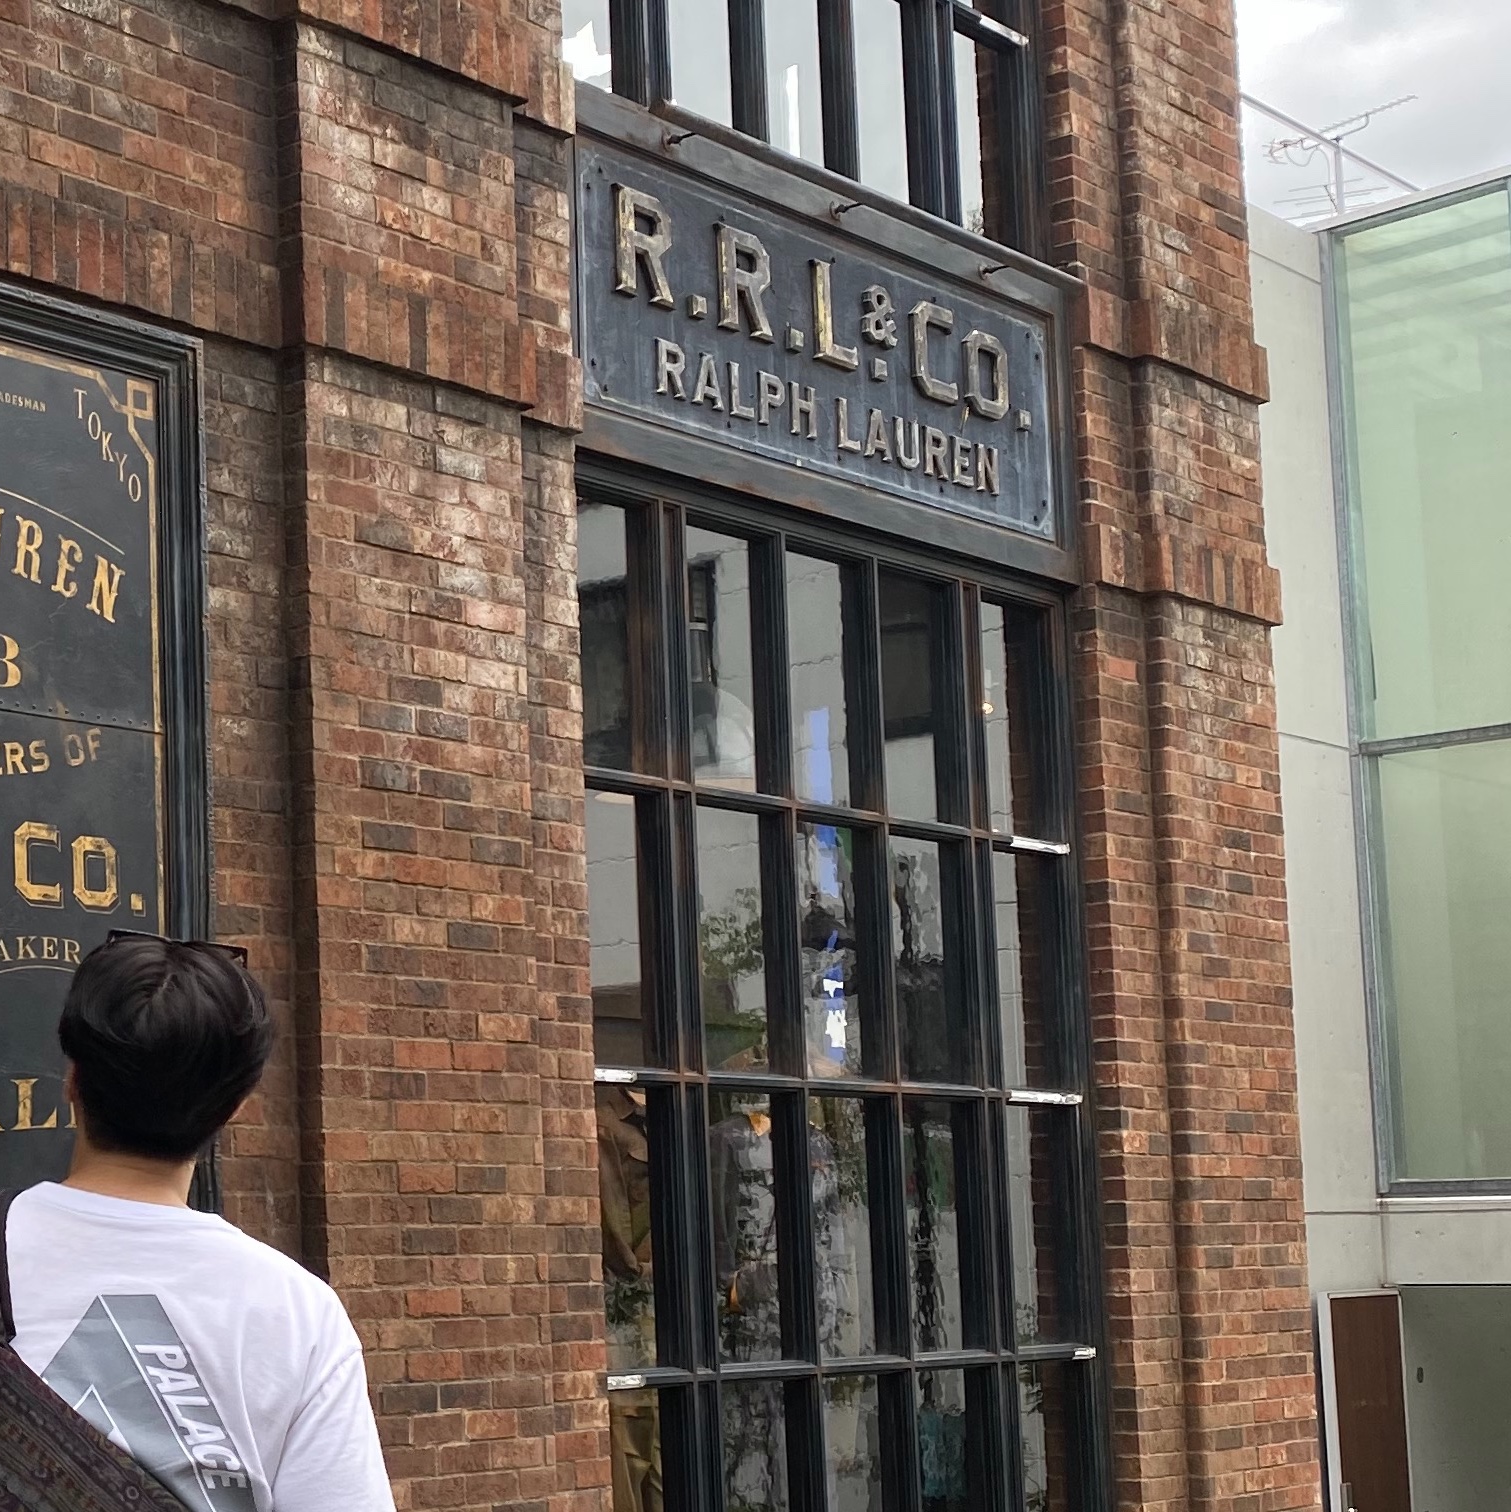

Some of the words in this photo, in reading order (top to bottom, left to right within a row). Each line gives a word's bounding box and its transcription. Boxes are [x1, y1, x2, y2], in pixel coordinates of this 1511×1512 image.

[73, 388, 143, 504] TOKYO
[655, 337, 818, 441] RALPH
[835, 396, 1000, 496] LAUREN
[64, 728, 105, 768] OF
[135, 1344, 248, 1490] PALACE
